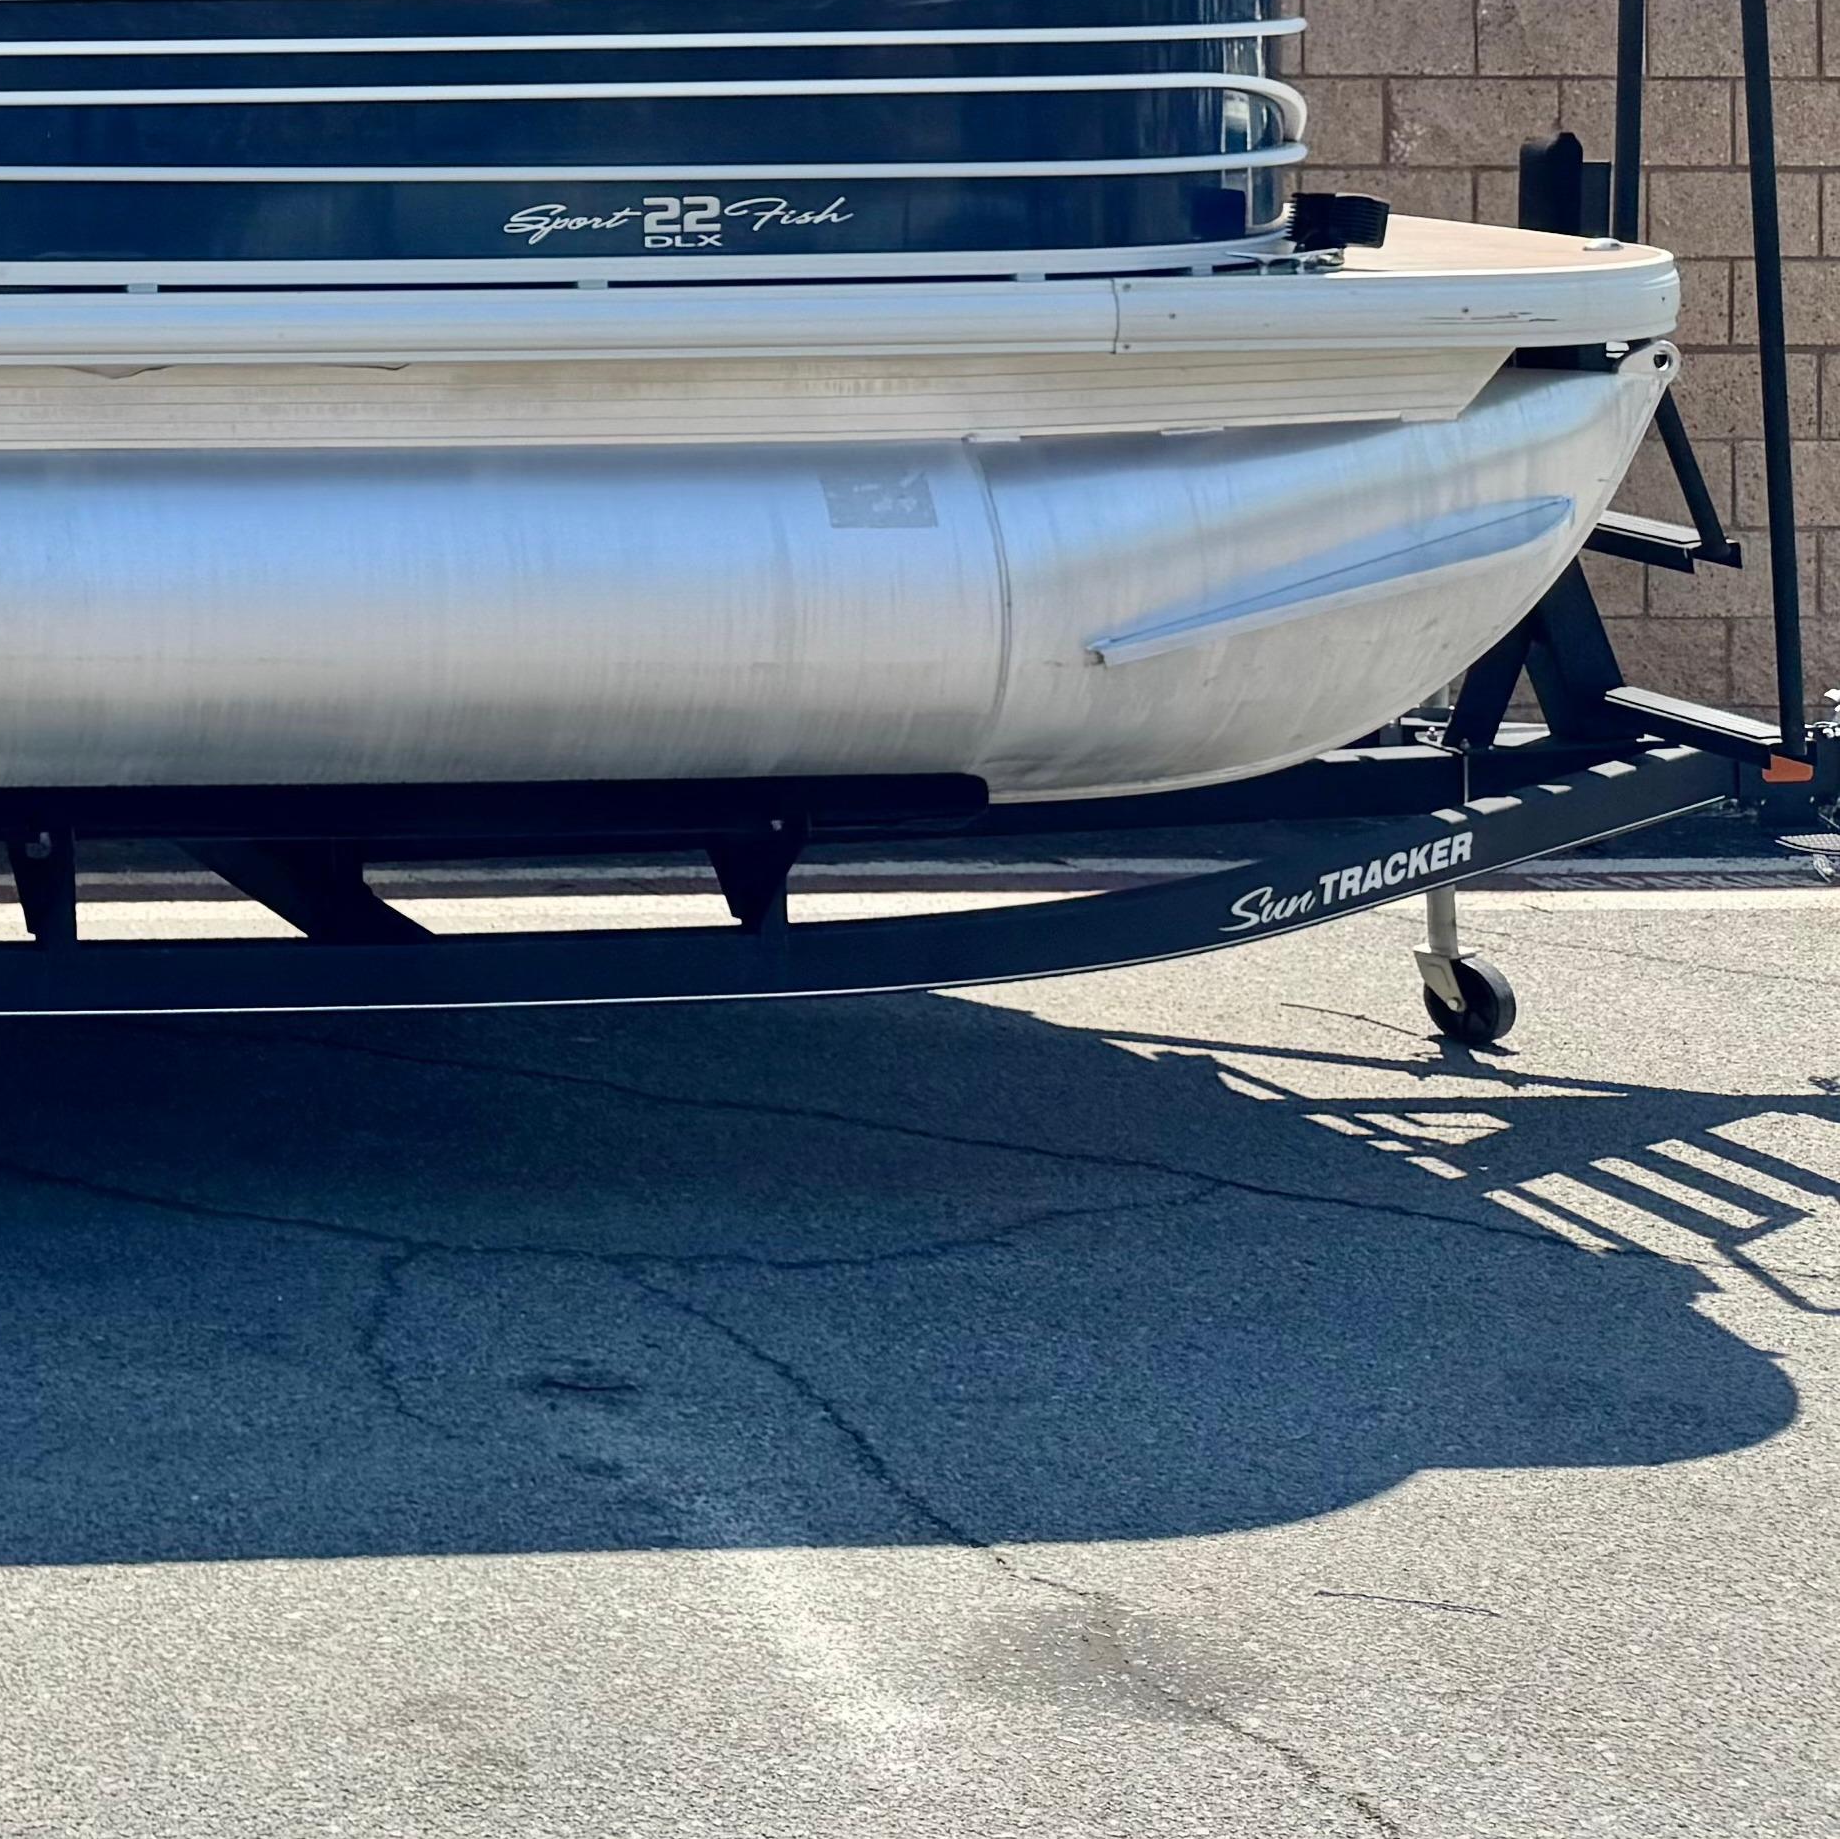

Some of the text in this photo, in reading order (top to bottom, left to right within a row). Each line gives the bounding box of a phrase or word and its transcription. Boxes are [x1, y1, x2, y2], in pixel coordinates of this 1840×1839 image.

[503, 196, 854, 245] Sport 22 Fish
[643, 234, 723, 249] DLX
[1219, 830, 1474, 933] Sun TRACKER
